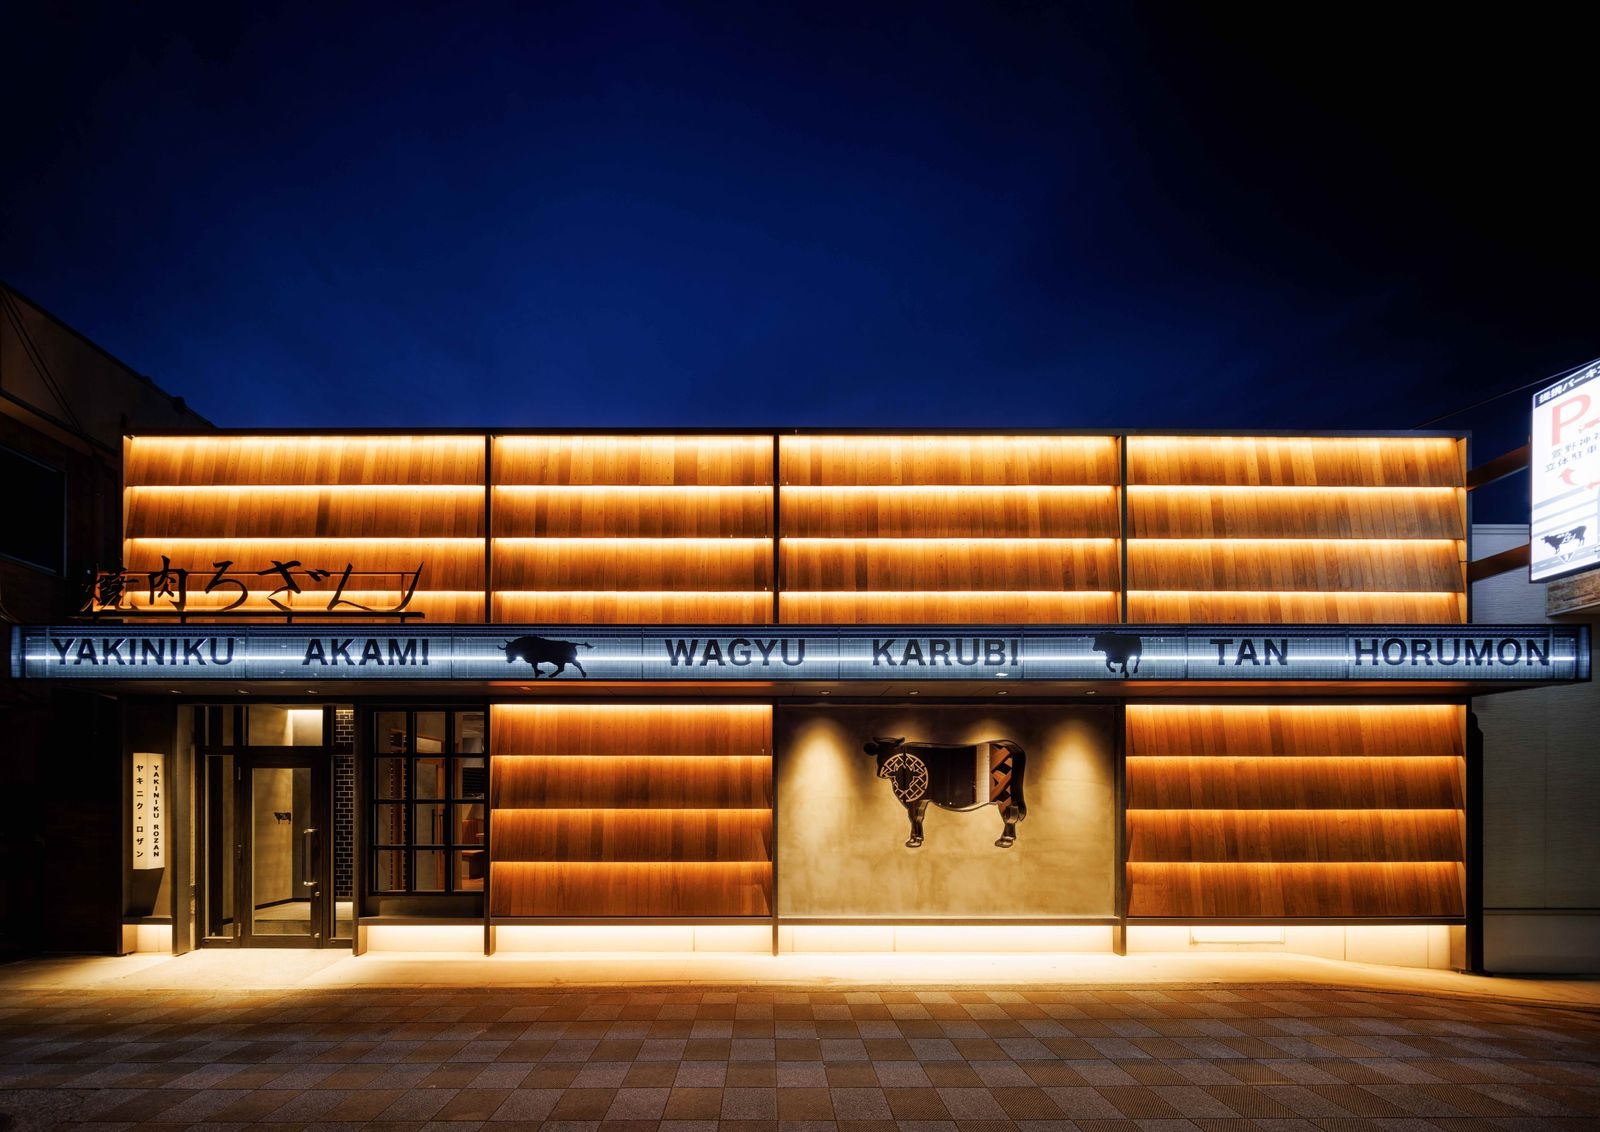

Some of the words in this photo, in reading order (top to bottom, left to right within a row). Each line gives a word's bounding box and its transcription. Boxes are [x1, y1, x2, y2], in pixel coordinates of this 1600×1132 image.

[1551, 393, 1591, 447] P
[51, 638, 235, 666] YAKINIKU
[302, 638, 430, 666] AKAMI
[664, 638, 806, 667] WAGYU
[872, 638, 1020, 667] KARUBI
[1210, 638, 1288, 666] TAN
[1354, 637, 1551, 666] HORUMON
